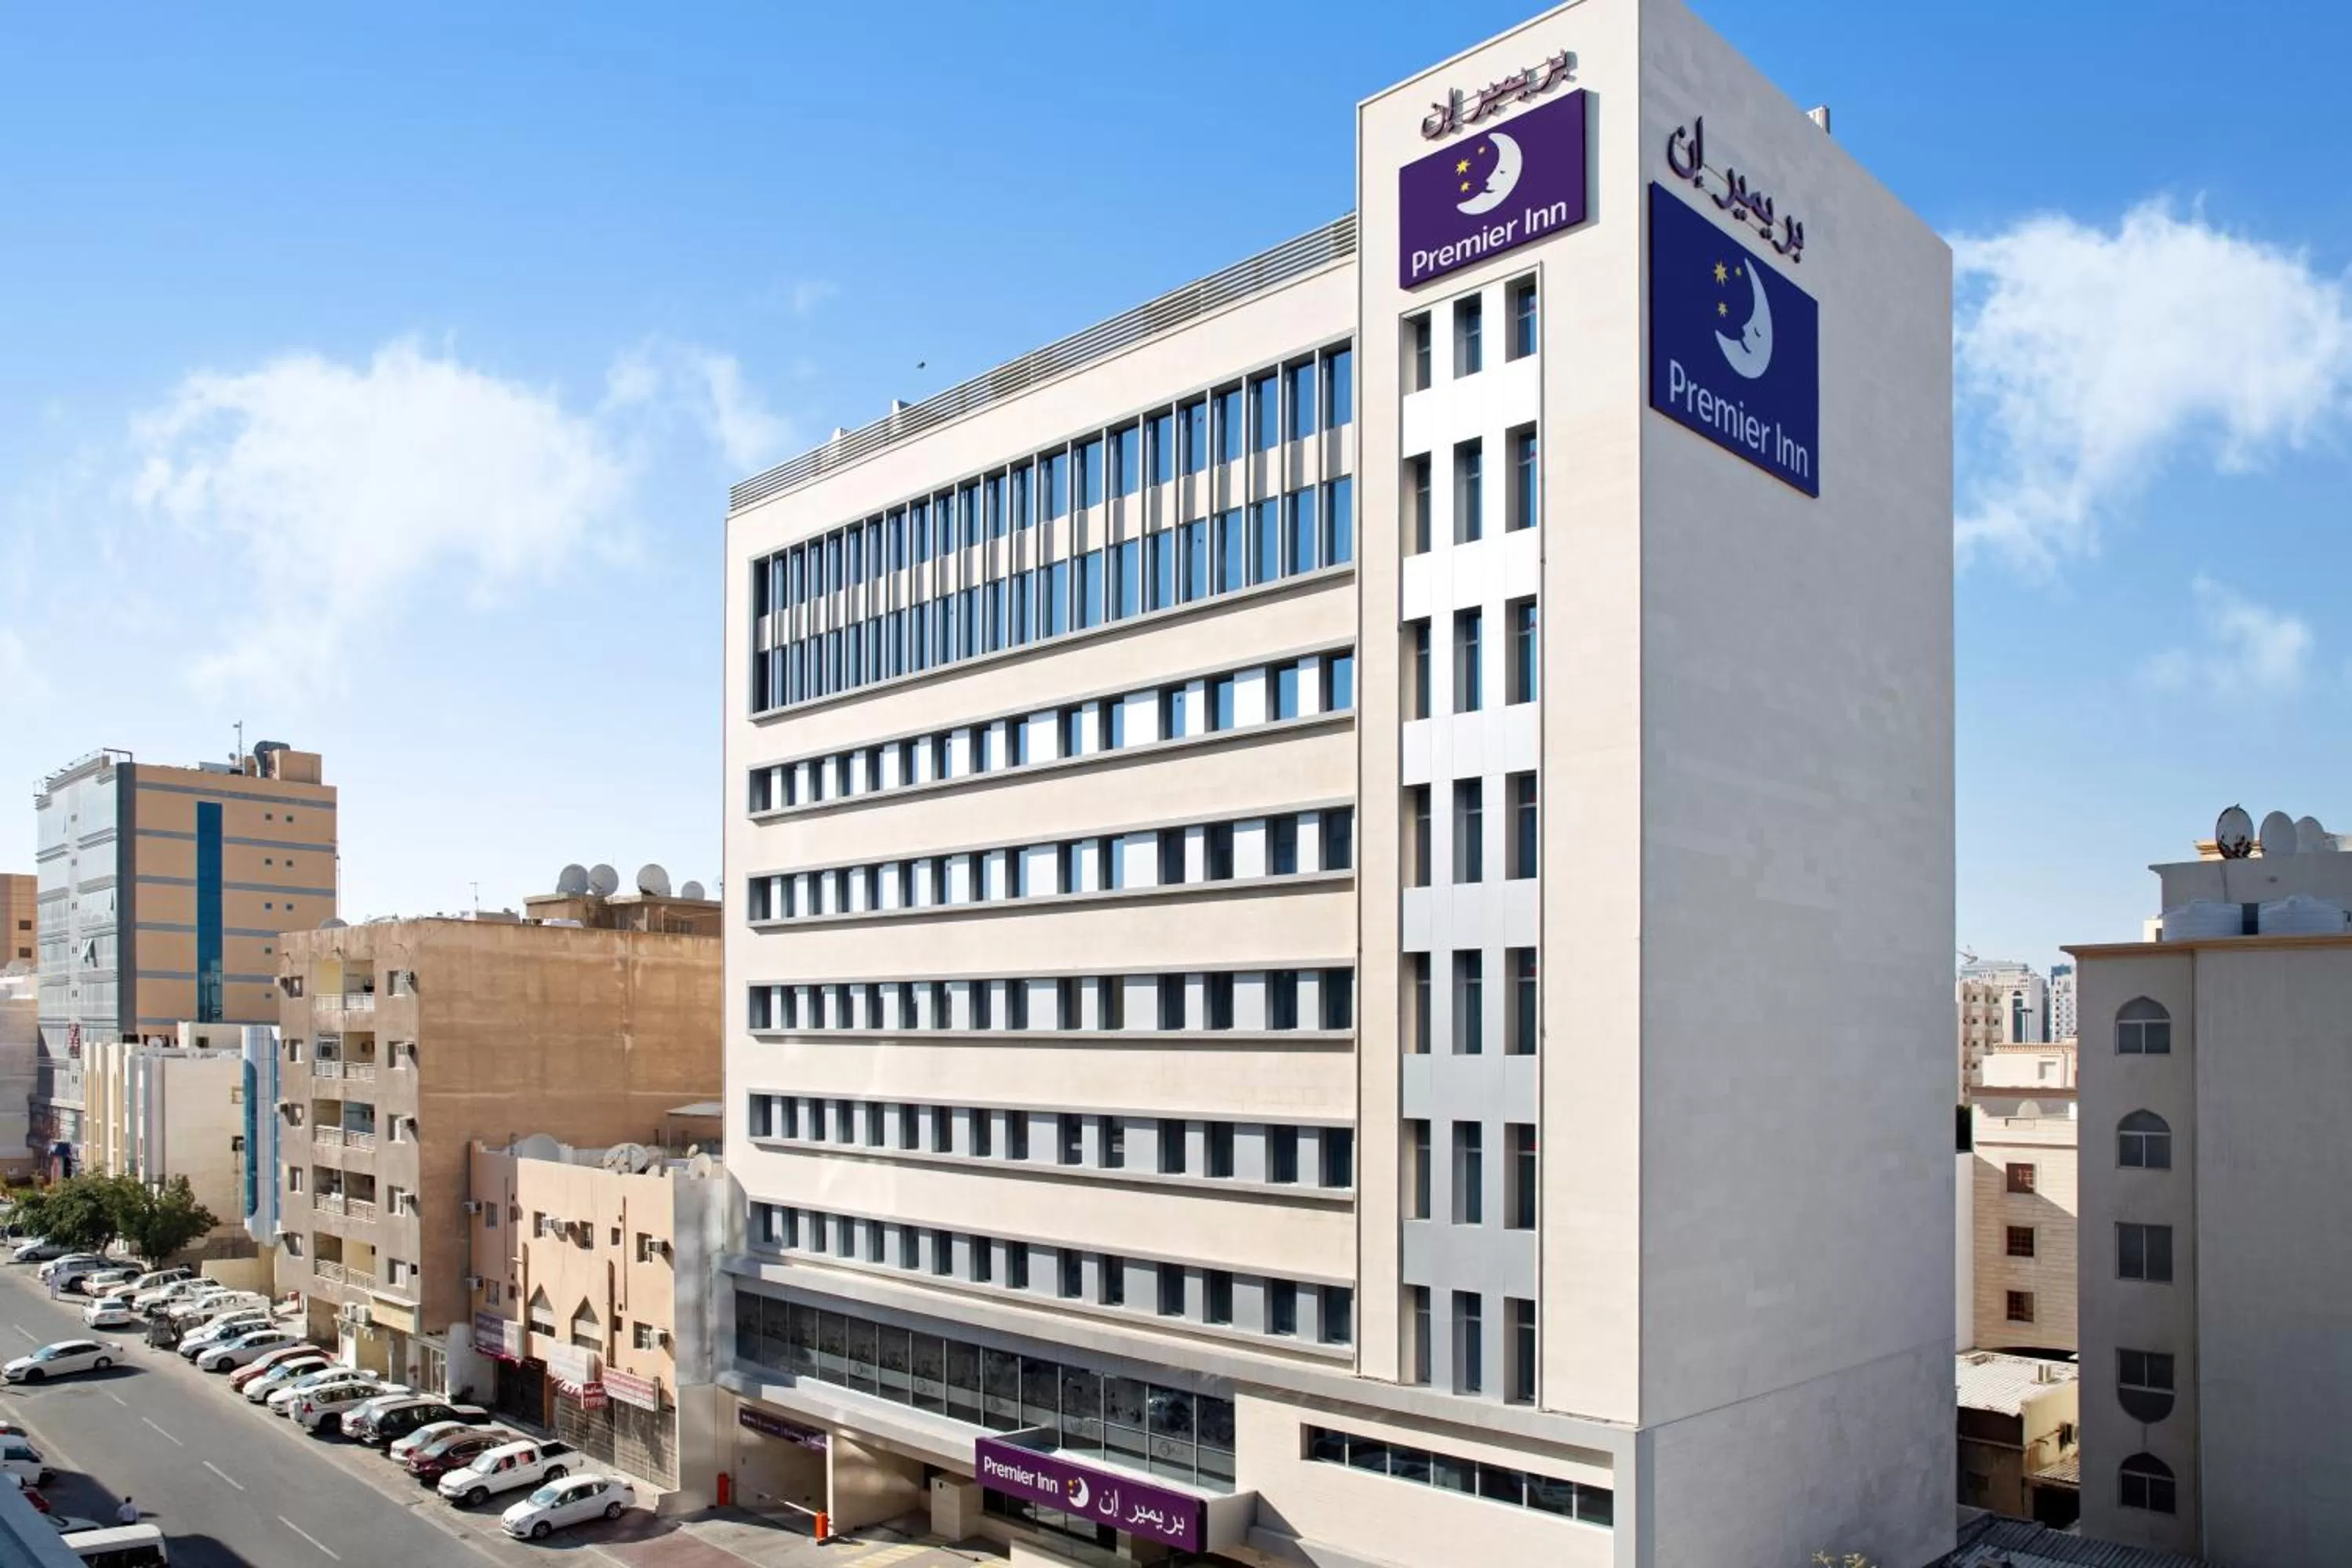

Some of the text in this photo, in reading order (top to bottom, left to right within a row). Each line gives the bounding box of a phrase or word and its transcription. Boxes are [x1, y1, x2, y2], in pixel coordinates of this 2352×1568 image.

[1461, 49, 1569, 124] بريمير
[1412, 201, 1567, 278] Premier Inn
[1711, 167, 1804, 263] بريمير
[1669, 358, 1808, 477] Premier Inn
[984, 1455, 1058, 1494] Premier Inn
[1098, 1489, 1185, 1537] بريمير إن
